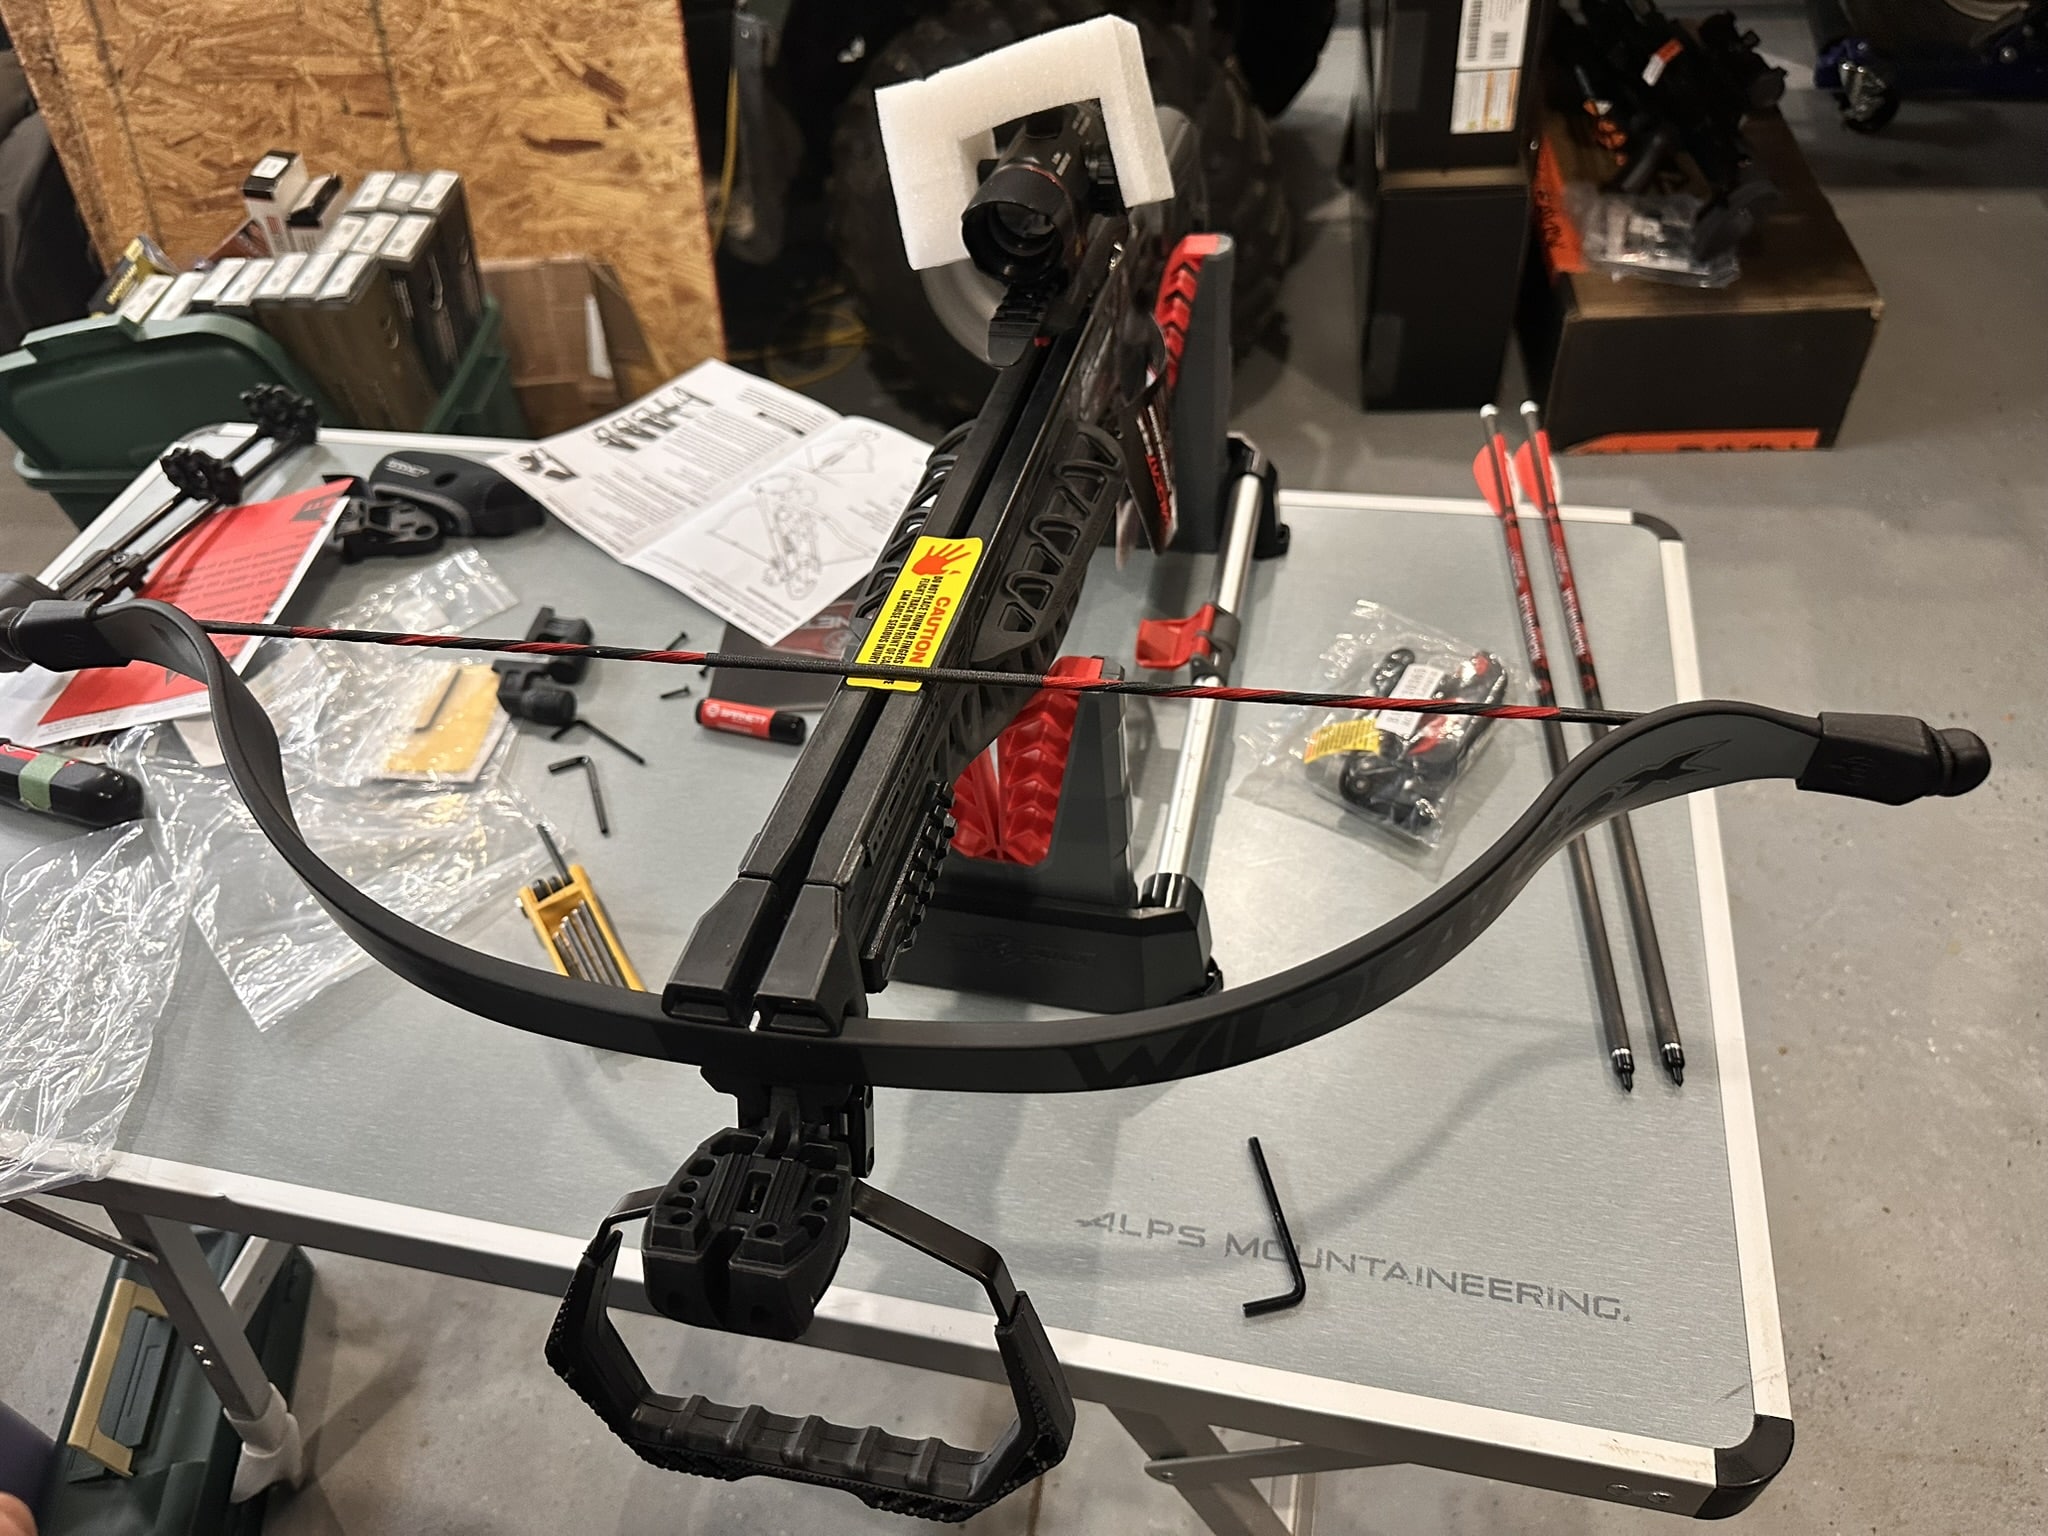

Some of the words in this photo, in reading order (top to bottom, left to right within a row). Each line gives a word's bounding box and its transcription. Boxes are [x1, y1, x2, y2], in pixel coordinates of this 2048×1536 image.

[899, 590, 913, 602] CAN
[914, 578, 930, 597] FLIGHT
[927, 584, 939, 595] NOT
[890, 601, 907, 619] CAUSE
[906, 596, 922, 614] TRACK
[919, 594, 934, 611] PLACE
[898, 622, 909, 630] IN
[902, 614, 913, 623] OR
[909, 611, 927, 631] THUMB
[878, 619, 898, 642] SERIOUS
[889, 629, 905, 647] FRONT
[905, 631, 917, 640] OR
[909, 597, 951, 663] CAUTION
[868, 643, 886, 663] INJURY
[885, 647, 896, 655] OF
[893, 640, 913, 664] FINGERS
[1075, 1211, 1206, 1248] ALPS
